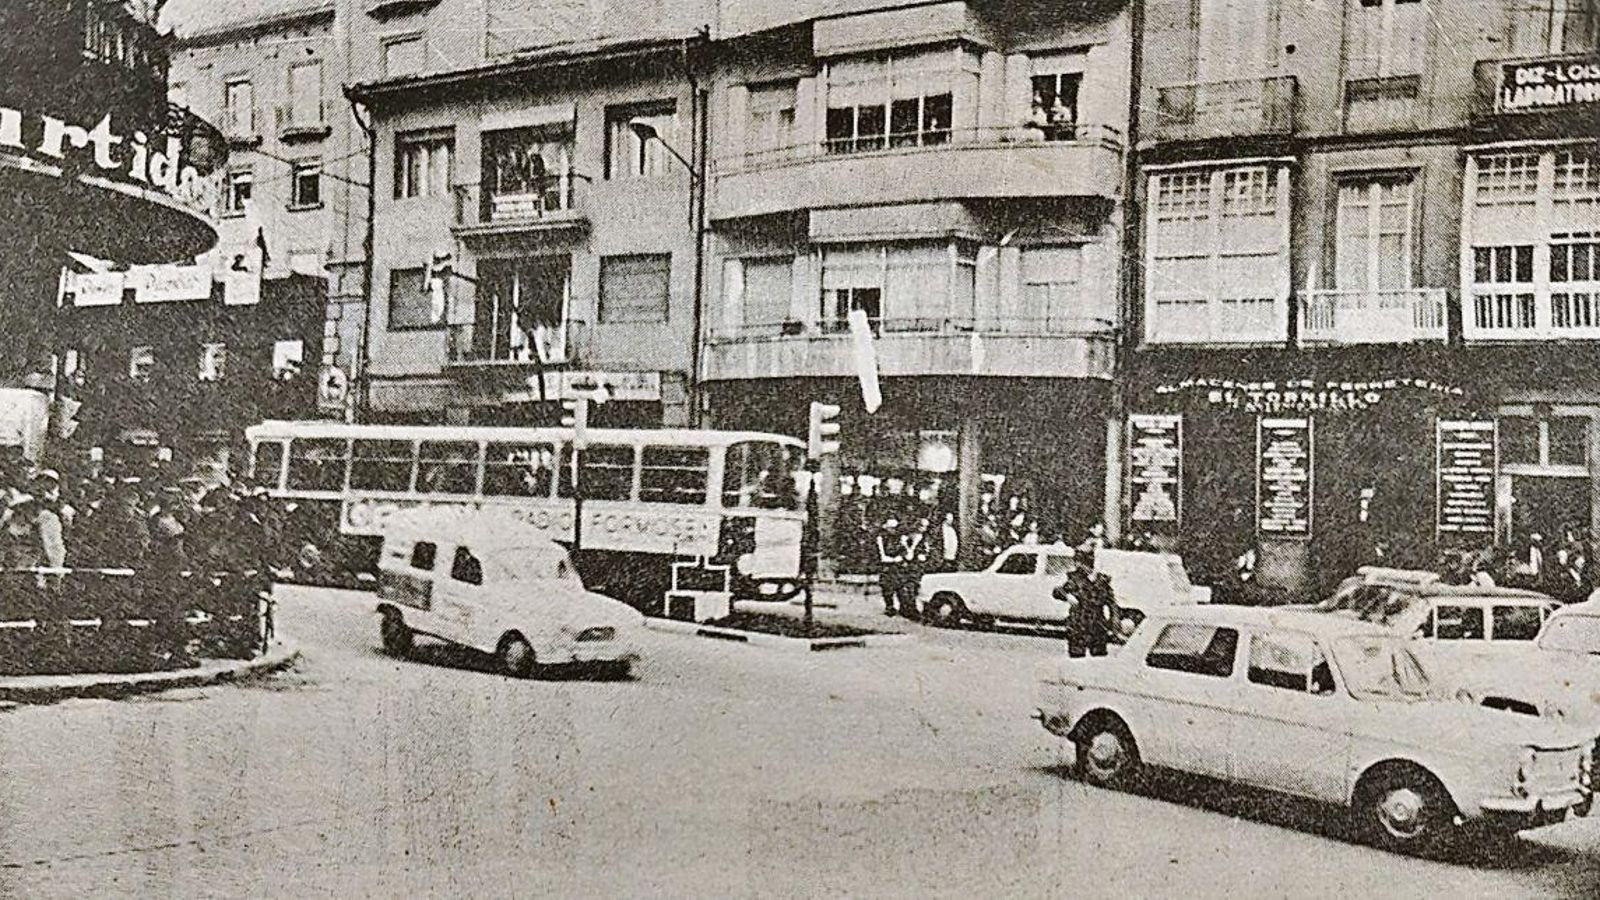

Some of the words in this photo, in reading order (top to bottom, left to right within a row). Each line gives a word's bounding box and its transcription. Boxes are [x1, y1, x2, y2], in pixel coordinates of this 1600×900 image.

[1155, 377, 1276, 394] ALMACENES
[1286, 379, 1313, 388] DE
[1326, 378, 1463, 396] FERRETERIA
[1247, 391, 1380, 404] TORNILLO
